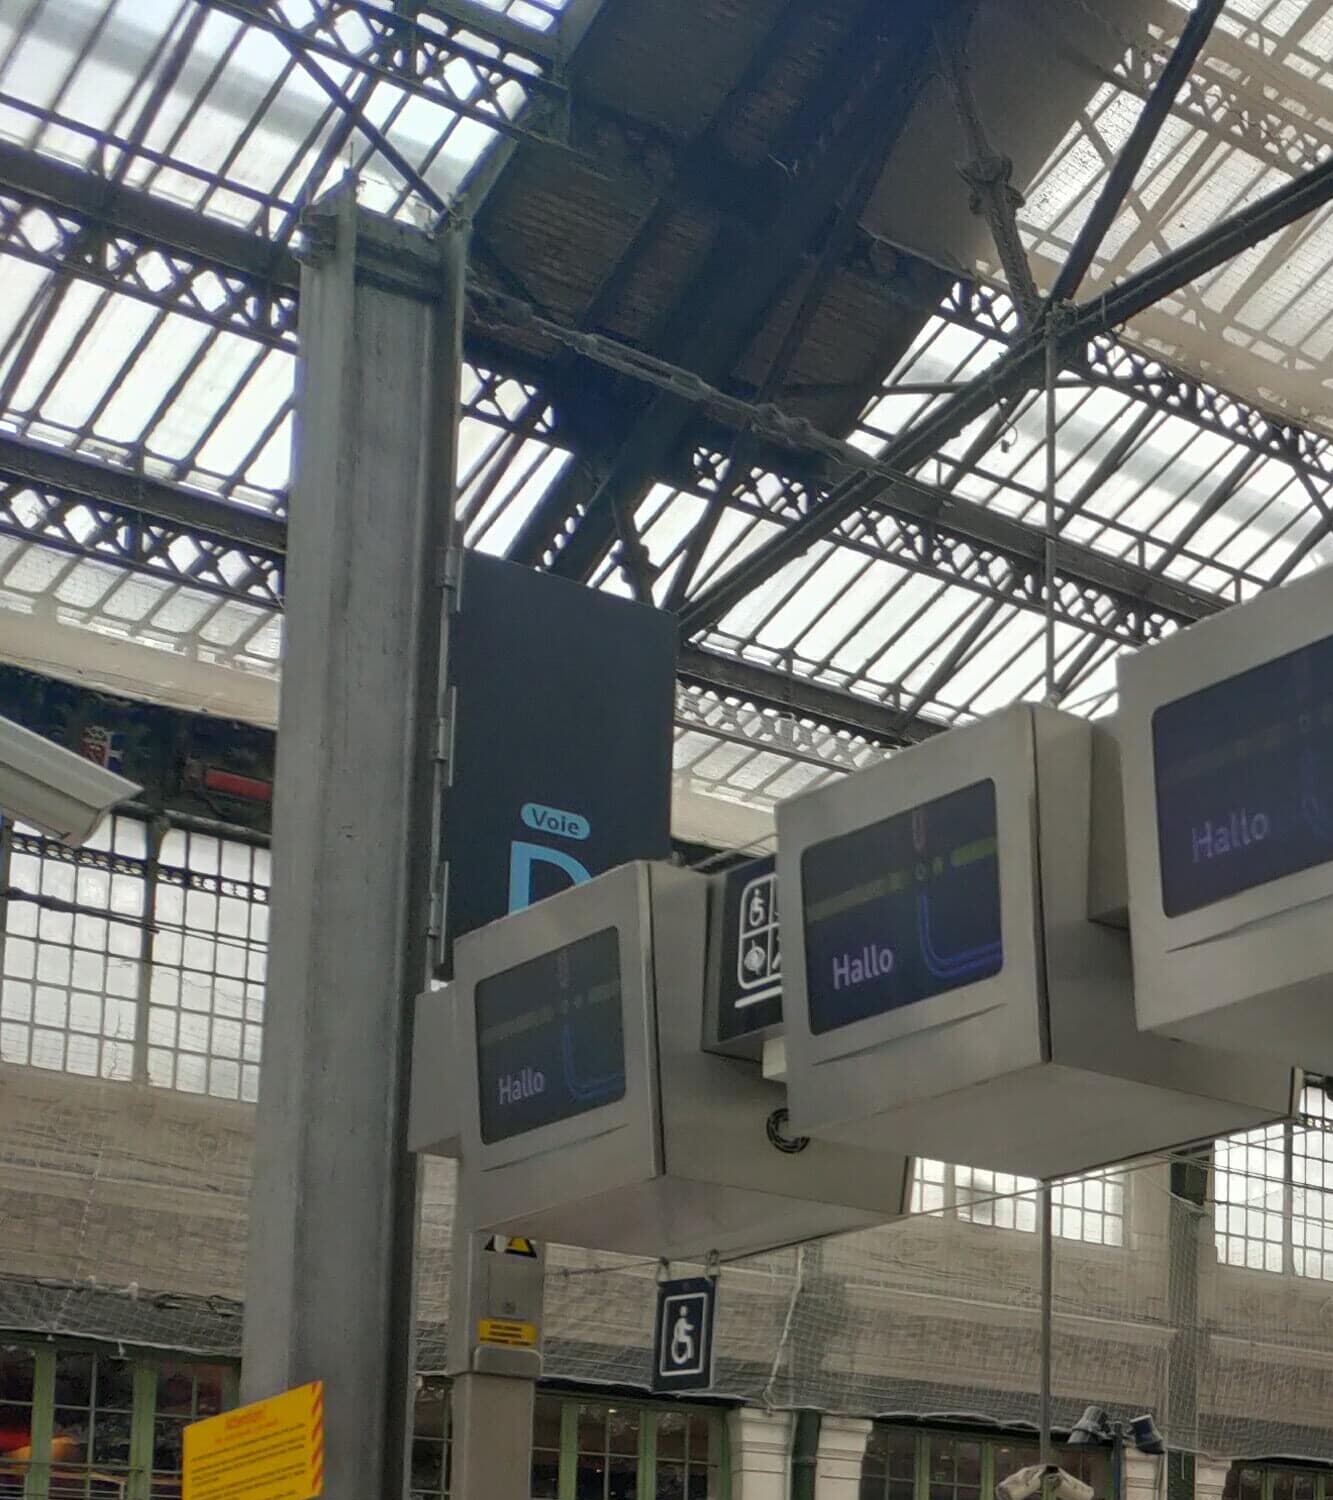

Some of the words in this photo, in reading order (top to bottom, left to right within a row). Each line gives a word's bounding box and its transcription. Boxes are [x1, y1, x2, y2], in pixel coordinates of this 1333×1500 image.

[531, 808, 580, 836] Voie
[1192, 808, 1269, 863] Hallo
[832, 943, 895, 990] Hallo
[498, 1066, 546, 1106] Hallo
